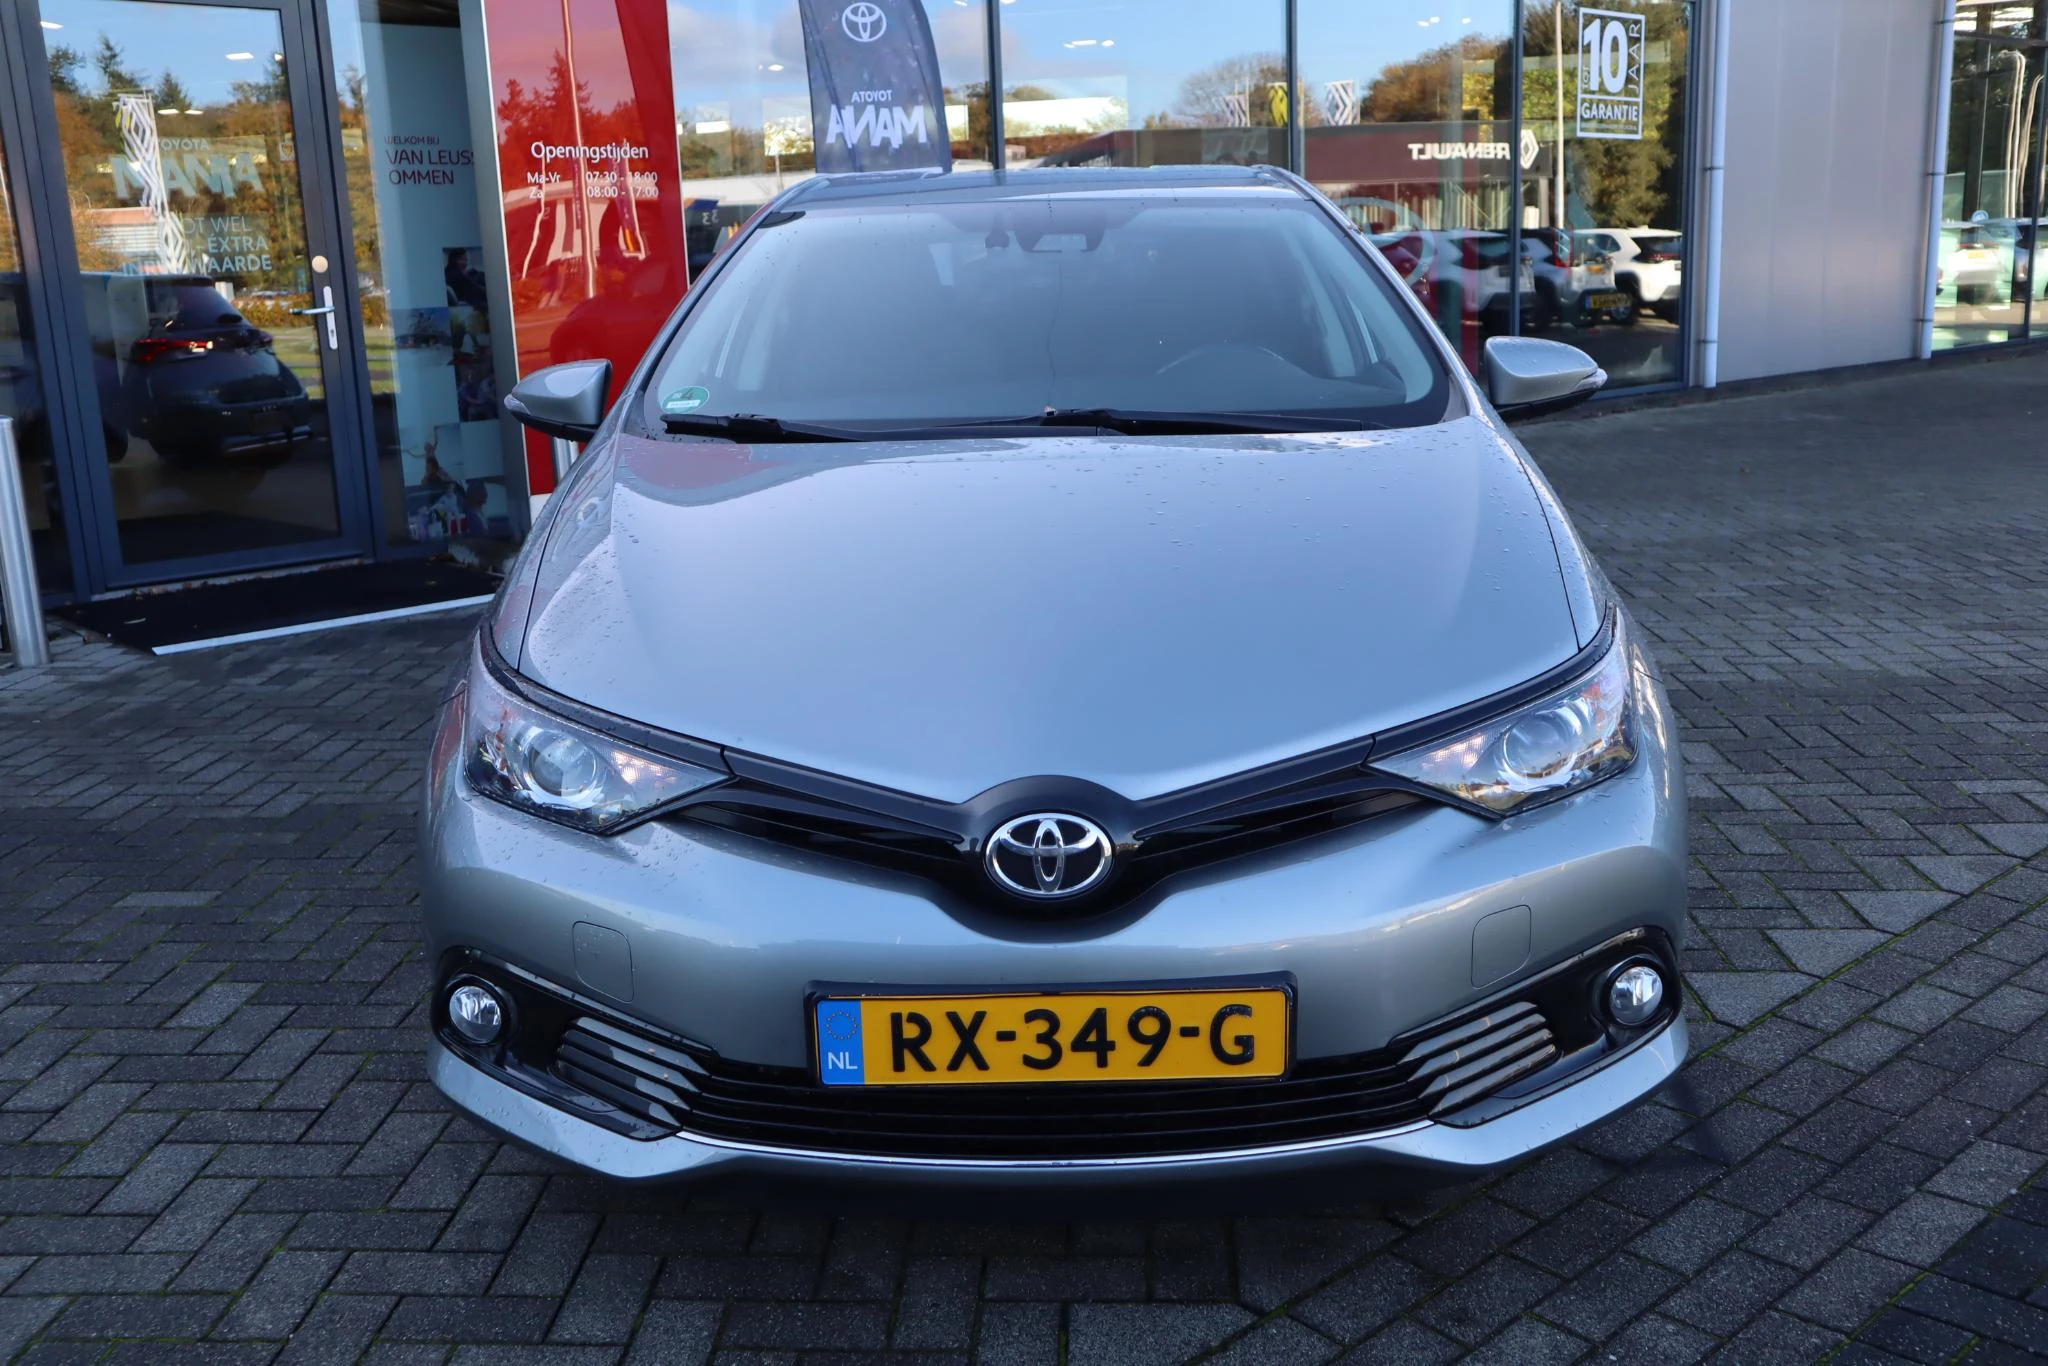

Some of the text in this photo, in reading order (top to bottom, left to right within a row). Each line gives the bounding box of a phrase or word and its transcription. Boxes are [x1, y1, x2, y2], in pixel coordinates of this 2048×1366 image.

[1583, 18, 1628, 93] 10
[1628, 23, 1640, 94] JAAR
[1581, 102, 1638, 120] GARANTIE
[386, 149, 424, 165] VAN
[531, 141, 648, 163] Openingstijden
[389, 169, 454, 185] OMMEN
[527, 171, 560, 184] Ma-Vr
[586, 171, 617, 183] 07:30
[529, 188, 544, 199] Za
[587, 186, 618, 198] 08:00
[184, 215, 253, 233] OT WEL
[890, 1003, 1255, 1073] RX-349-G
[827, 1052, 858, 1071] NL
